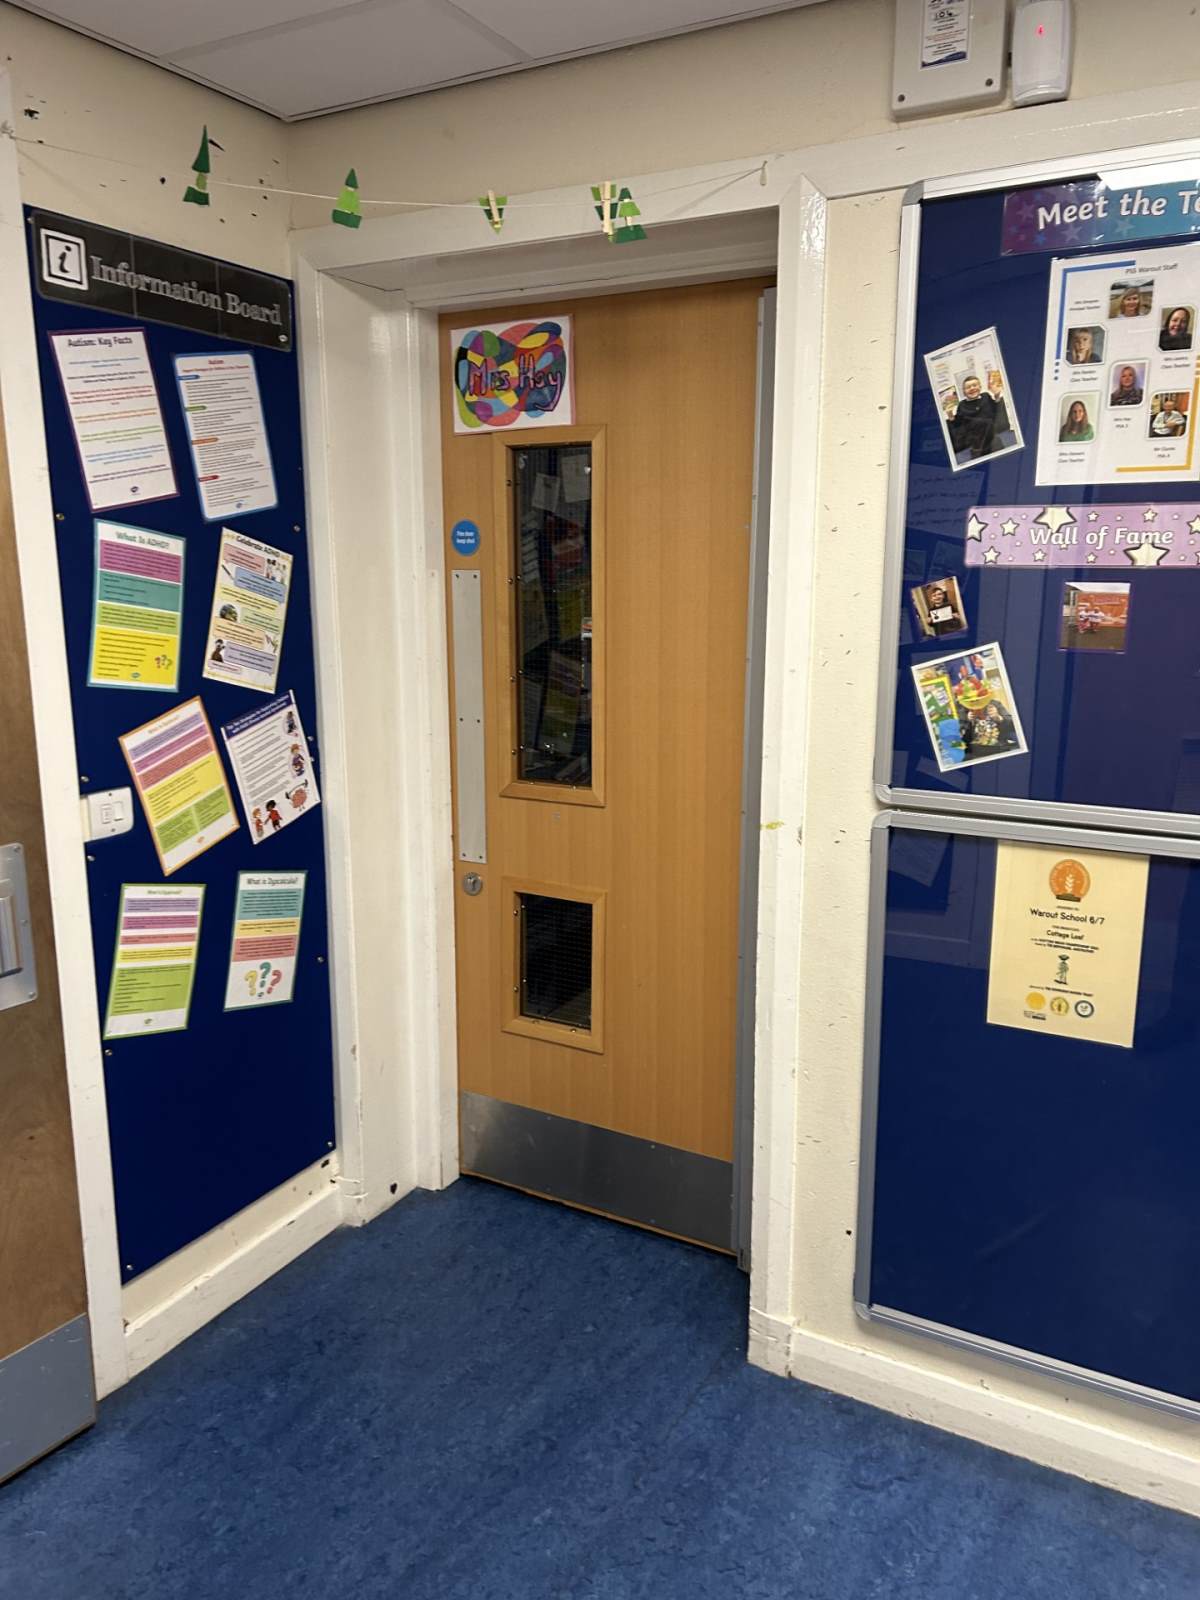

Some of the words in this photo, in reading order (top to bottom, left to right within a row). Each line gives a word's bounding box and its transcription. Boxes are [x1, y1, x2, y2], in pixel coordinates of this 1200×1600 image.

[1037, 195, 1108, 230] Meet
[1120, 189, 1168, 216] the
[89, 255, 224, 311] Information
[226, 293, 284, 326] Board
[468, 357, 511, 396] Mrs
[518, 352, 563, 412] Hay
[1029, 526, 1078, 546] Wall
[1085, 526, 1109, 550] of
[1115, 528, 1174, 545] Fame
[1029, 907, 1058, 918] Warout
[1060, 911, 1088, 923] School
